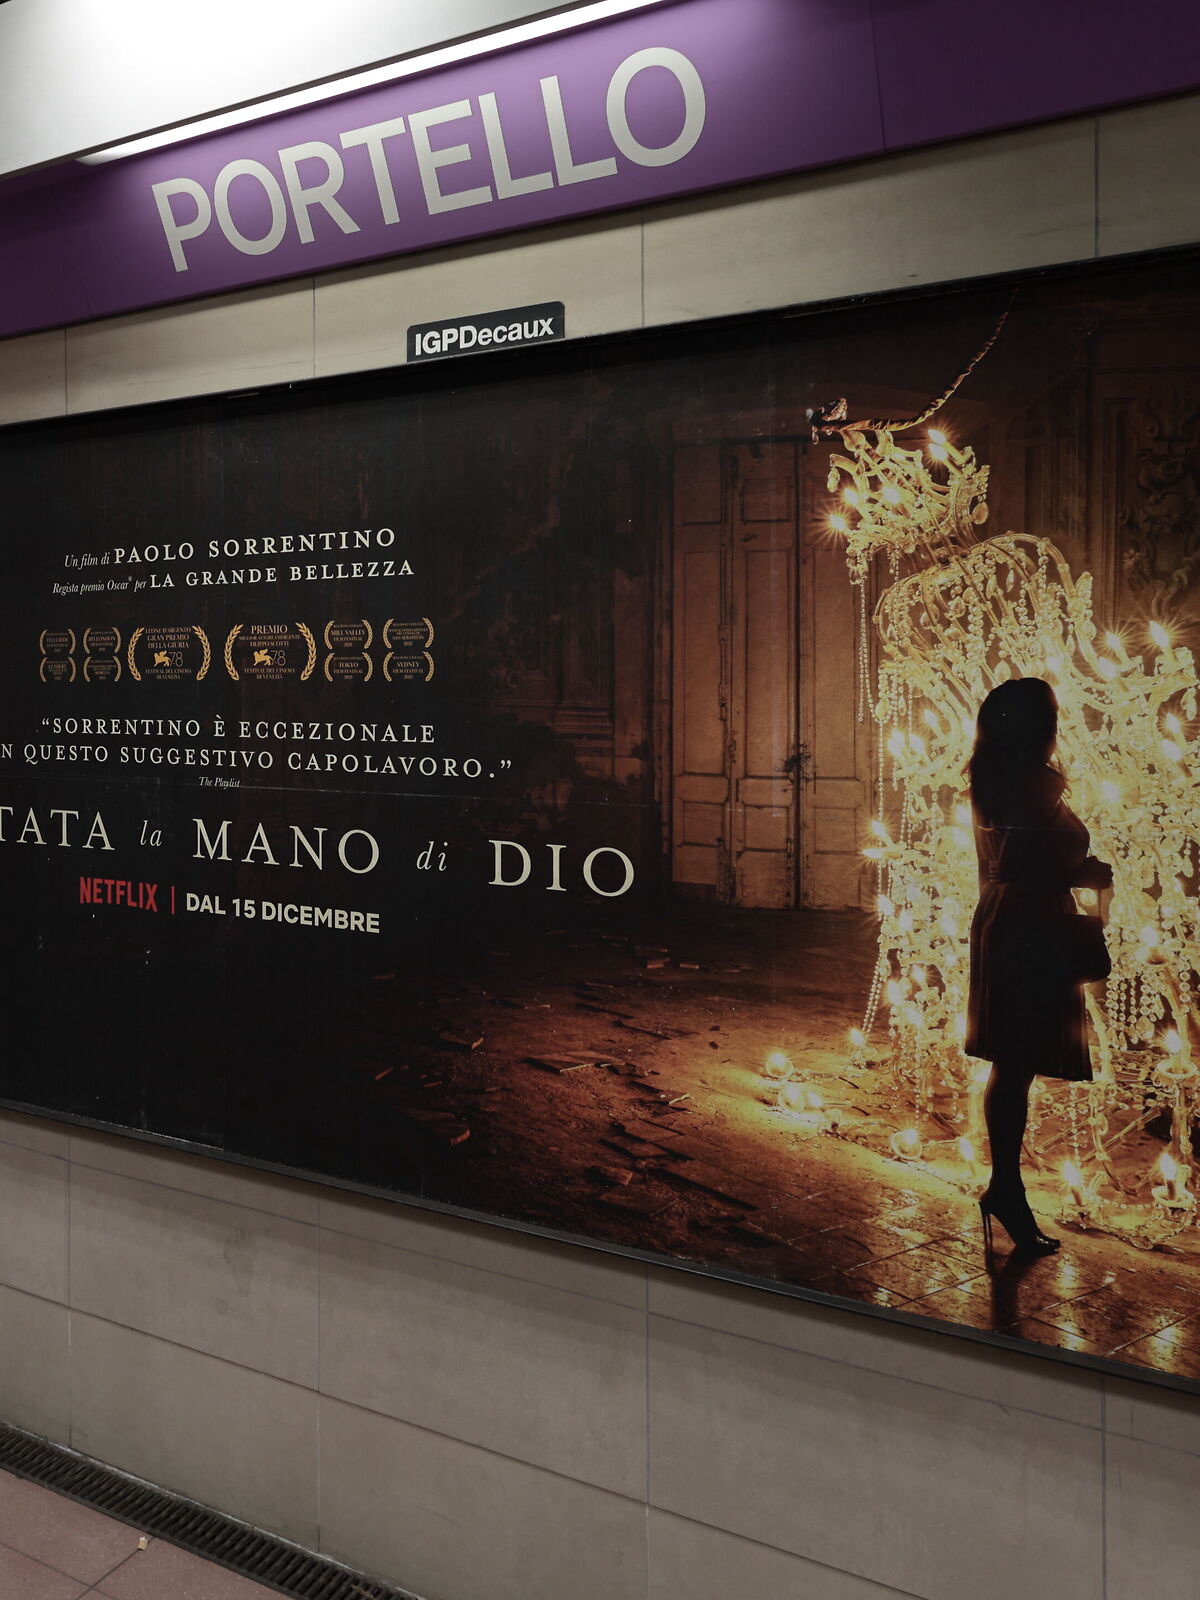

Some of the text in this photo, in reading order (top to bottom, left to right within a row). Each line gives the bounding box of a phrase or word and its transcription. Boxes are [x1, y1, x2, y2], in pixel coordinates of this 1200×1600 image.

[151, 46, 706, 272] PORTELLO
[415, 317, 555, 356] IGPDecaux
[64, 527, 395, 571] Un film di PAOLO SORRENTINO
[52, 582, 79, 596] Regista
[80, 580, 105, 596] premio
[134, 579, 148, 592] per
[150, 573, 175, 588] LA
[185, 567, 277, 587] GRANDE
[289, 559, 415, 581] BELLEZZA
[251, 624, 288, 634] PREMIO
[169, 651, 184, 668] 78
[271, 650, 286, 667] 78
[42, 714, 435, 743] “SORRENTINO È ECCEZIONALE
[24, 743, 109, 765] QUESTO
[120, 747, 274, 769] SUGGESTIVO
[287, 752, 512, 779] CAPOLAVORO.”
[199, 776, 241, 790] The Playlist
[139, 820, 163, 847] la
[192, 818, 380, 874] MANO
[416, 840, 448, 872] di
[488, 839, 635, 898] DIO
[79, 876, 159, 912] NETFLIX
[186, 892, 380, 934] DAL 15 DICEMBRE
